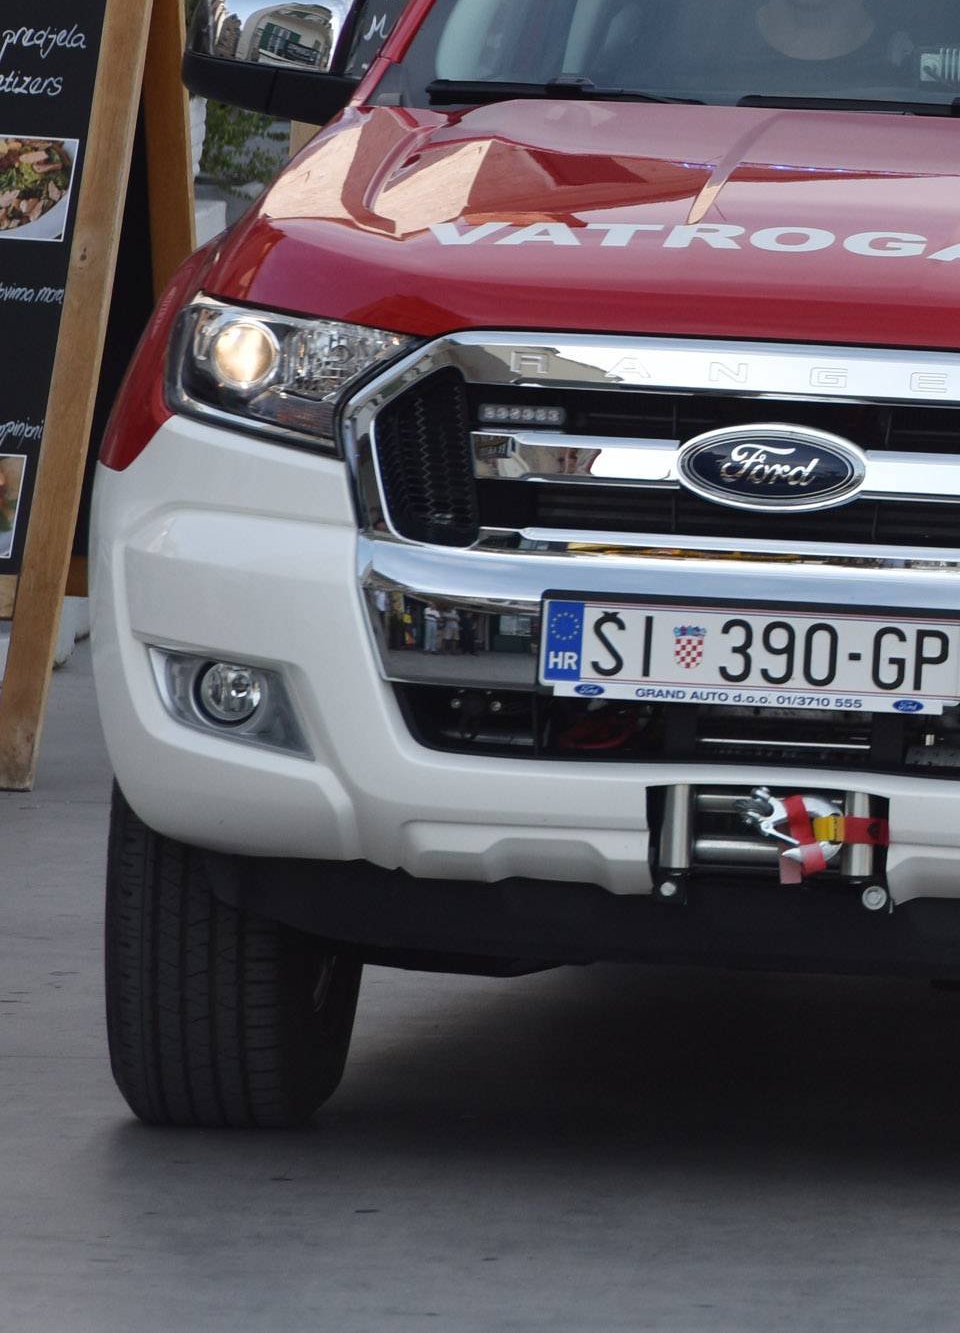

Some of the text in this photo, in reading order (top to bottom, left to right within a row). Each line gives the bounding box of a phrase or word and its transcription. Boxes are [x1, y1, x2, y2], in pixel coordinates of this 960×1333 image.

[720, 443, 820, 486] Ford
[549, 651, 578, 671] HR
[591, 611, 950, 692] ŠI 390-GP
[635, 687, 863, 709] GRAND AUTO d.o.o. 01/3710 555
